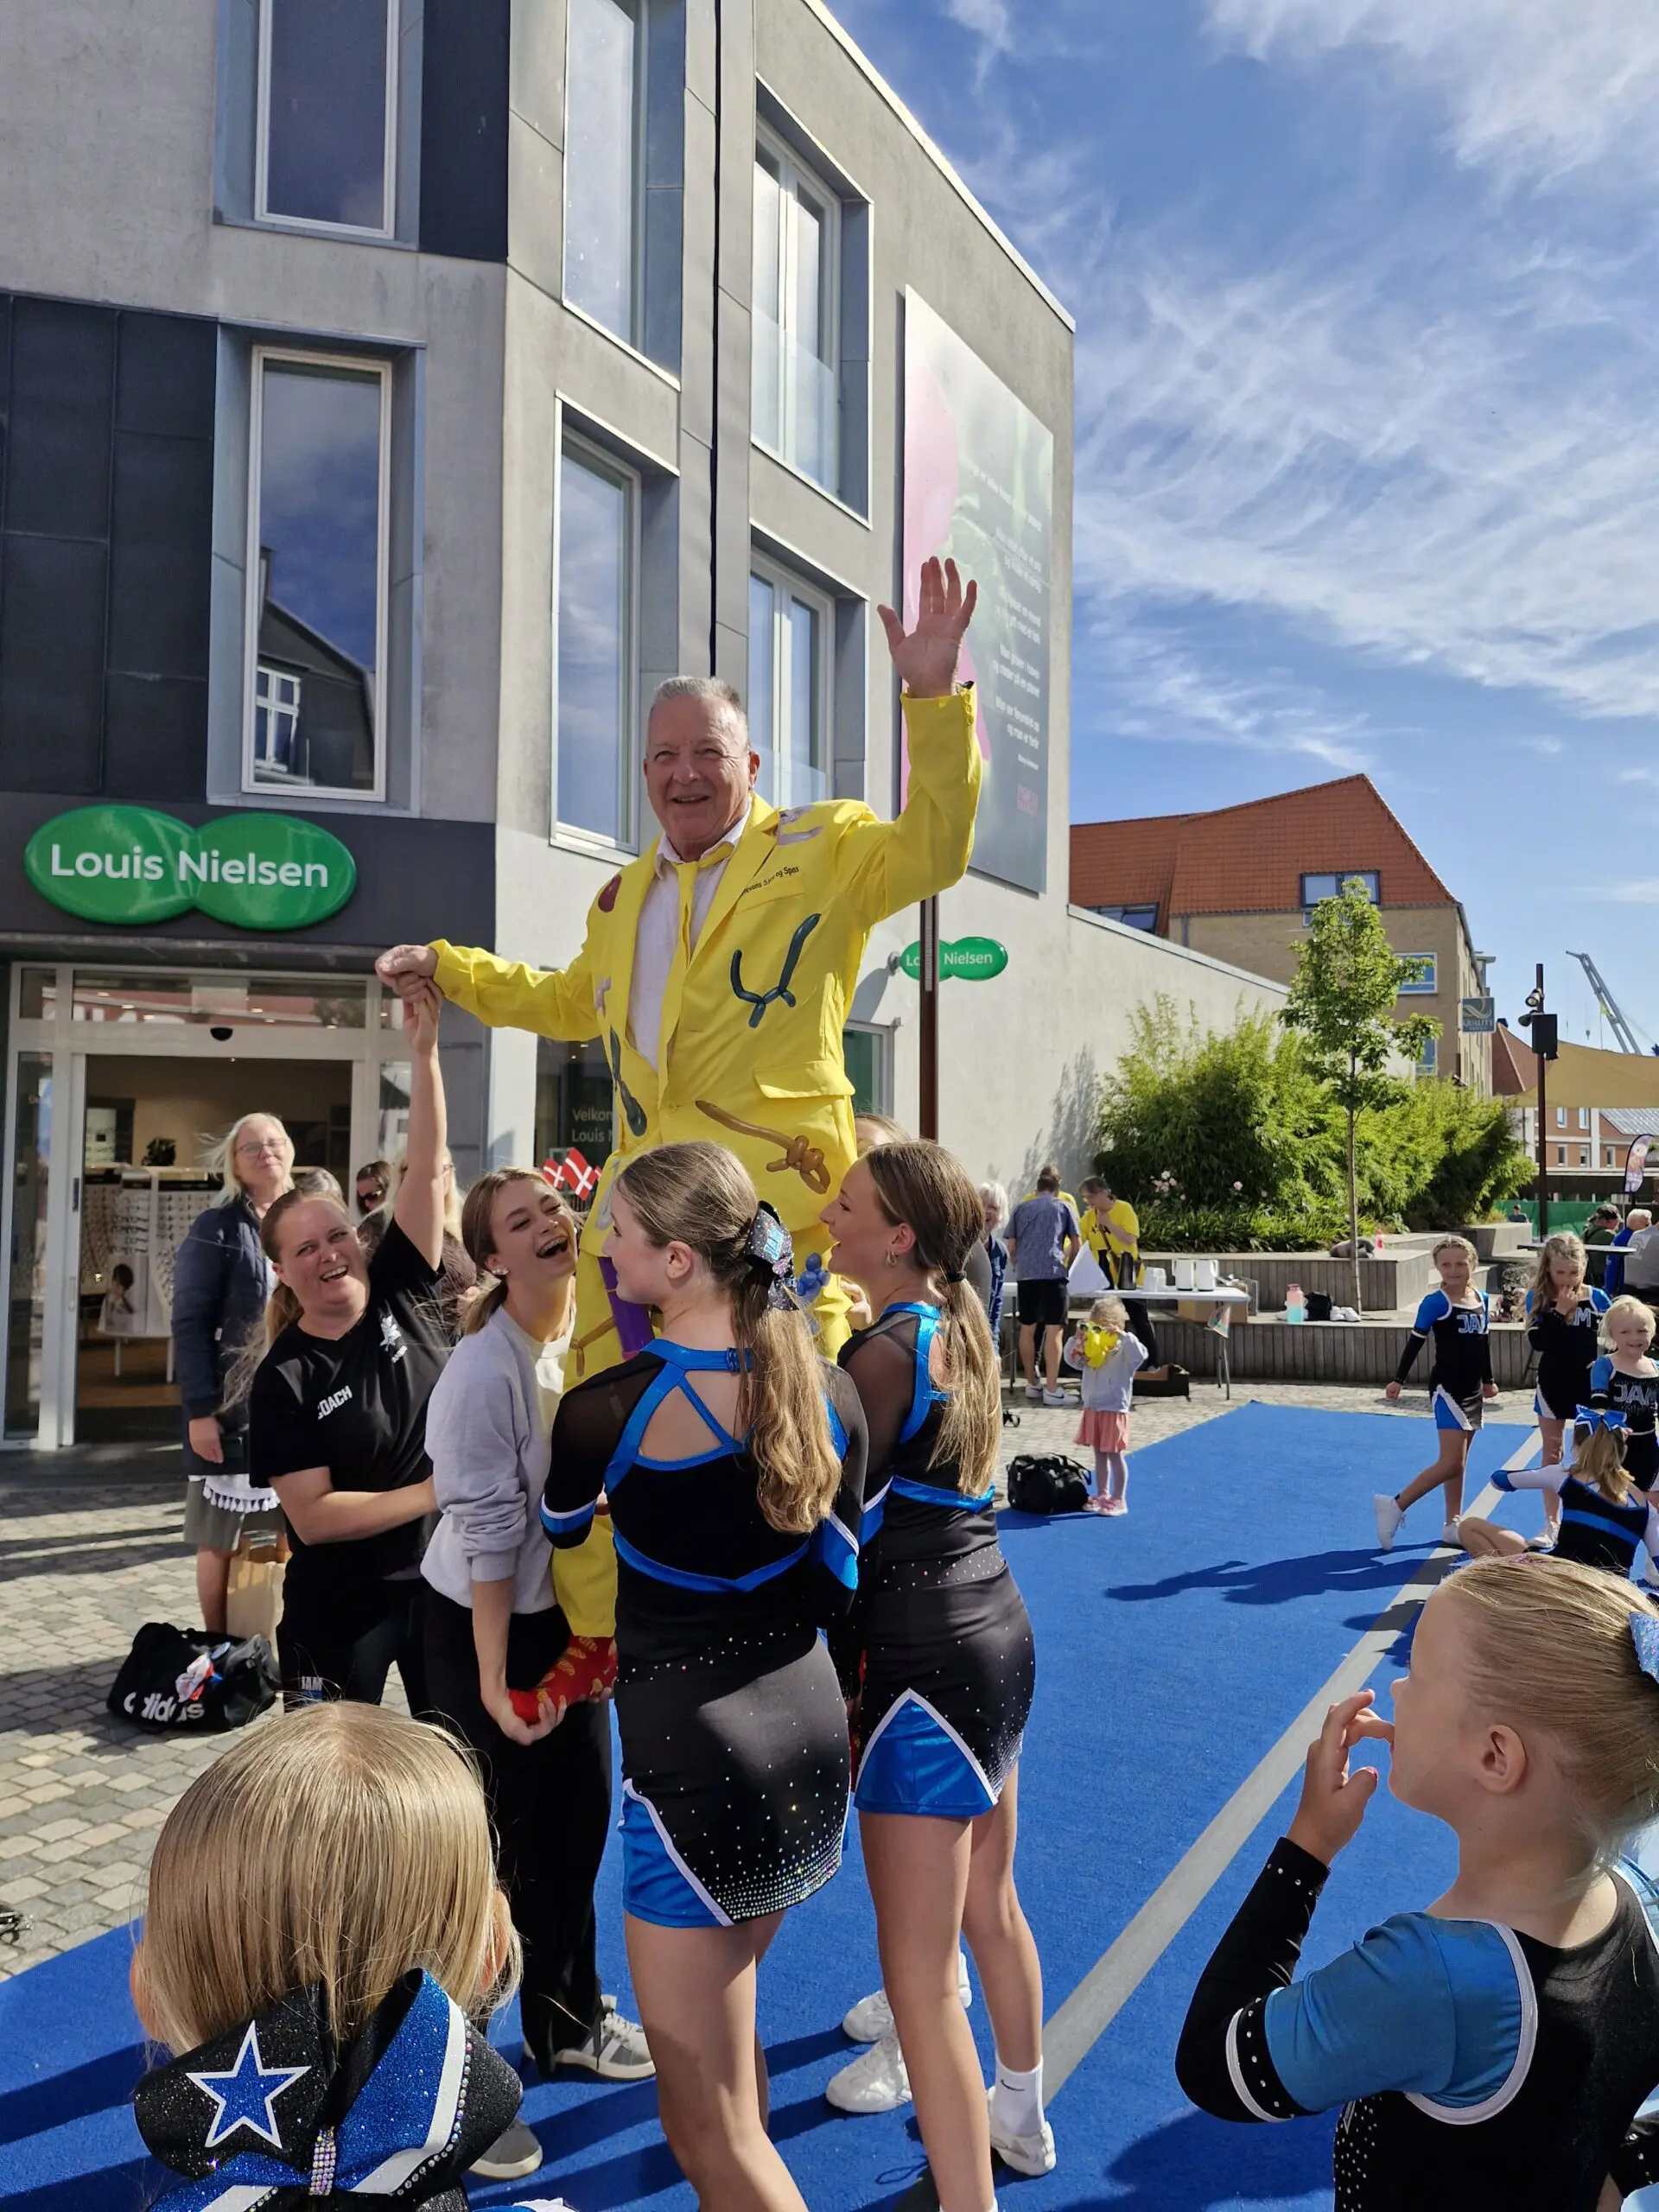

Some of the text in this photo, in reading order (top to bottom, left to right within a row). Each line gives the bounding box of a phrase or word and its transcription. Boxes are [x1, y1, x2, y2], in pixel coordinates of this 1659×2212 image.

[51, 844, 328, 888] Louis Nielsen
[783, 867, 799, 876] Spas
[944, 951, 993, 965] Nielsen
[571, 1128, 604, 1142] Louis
